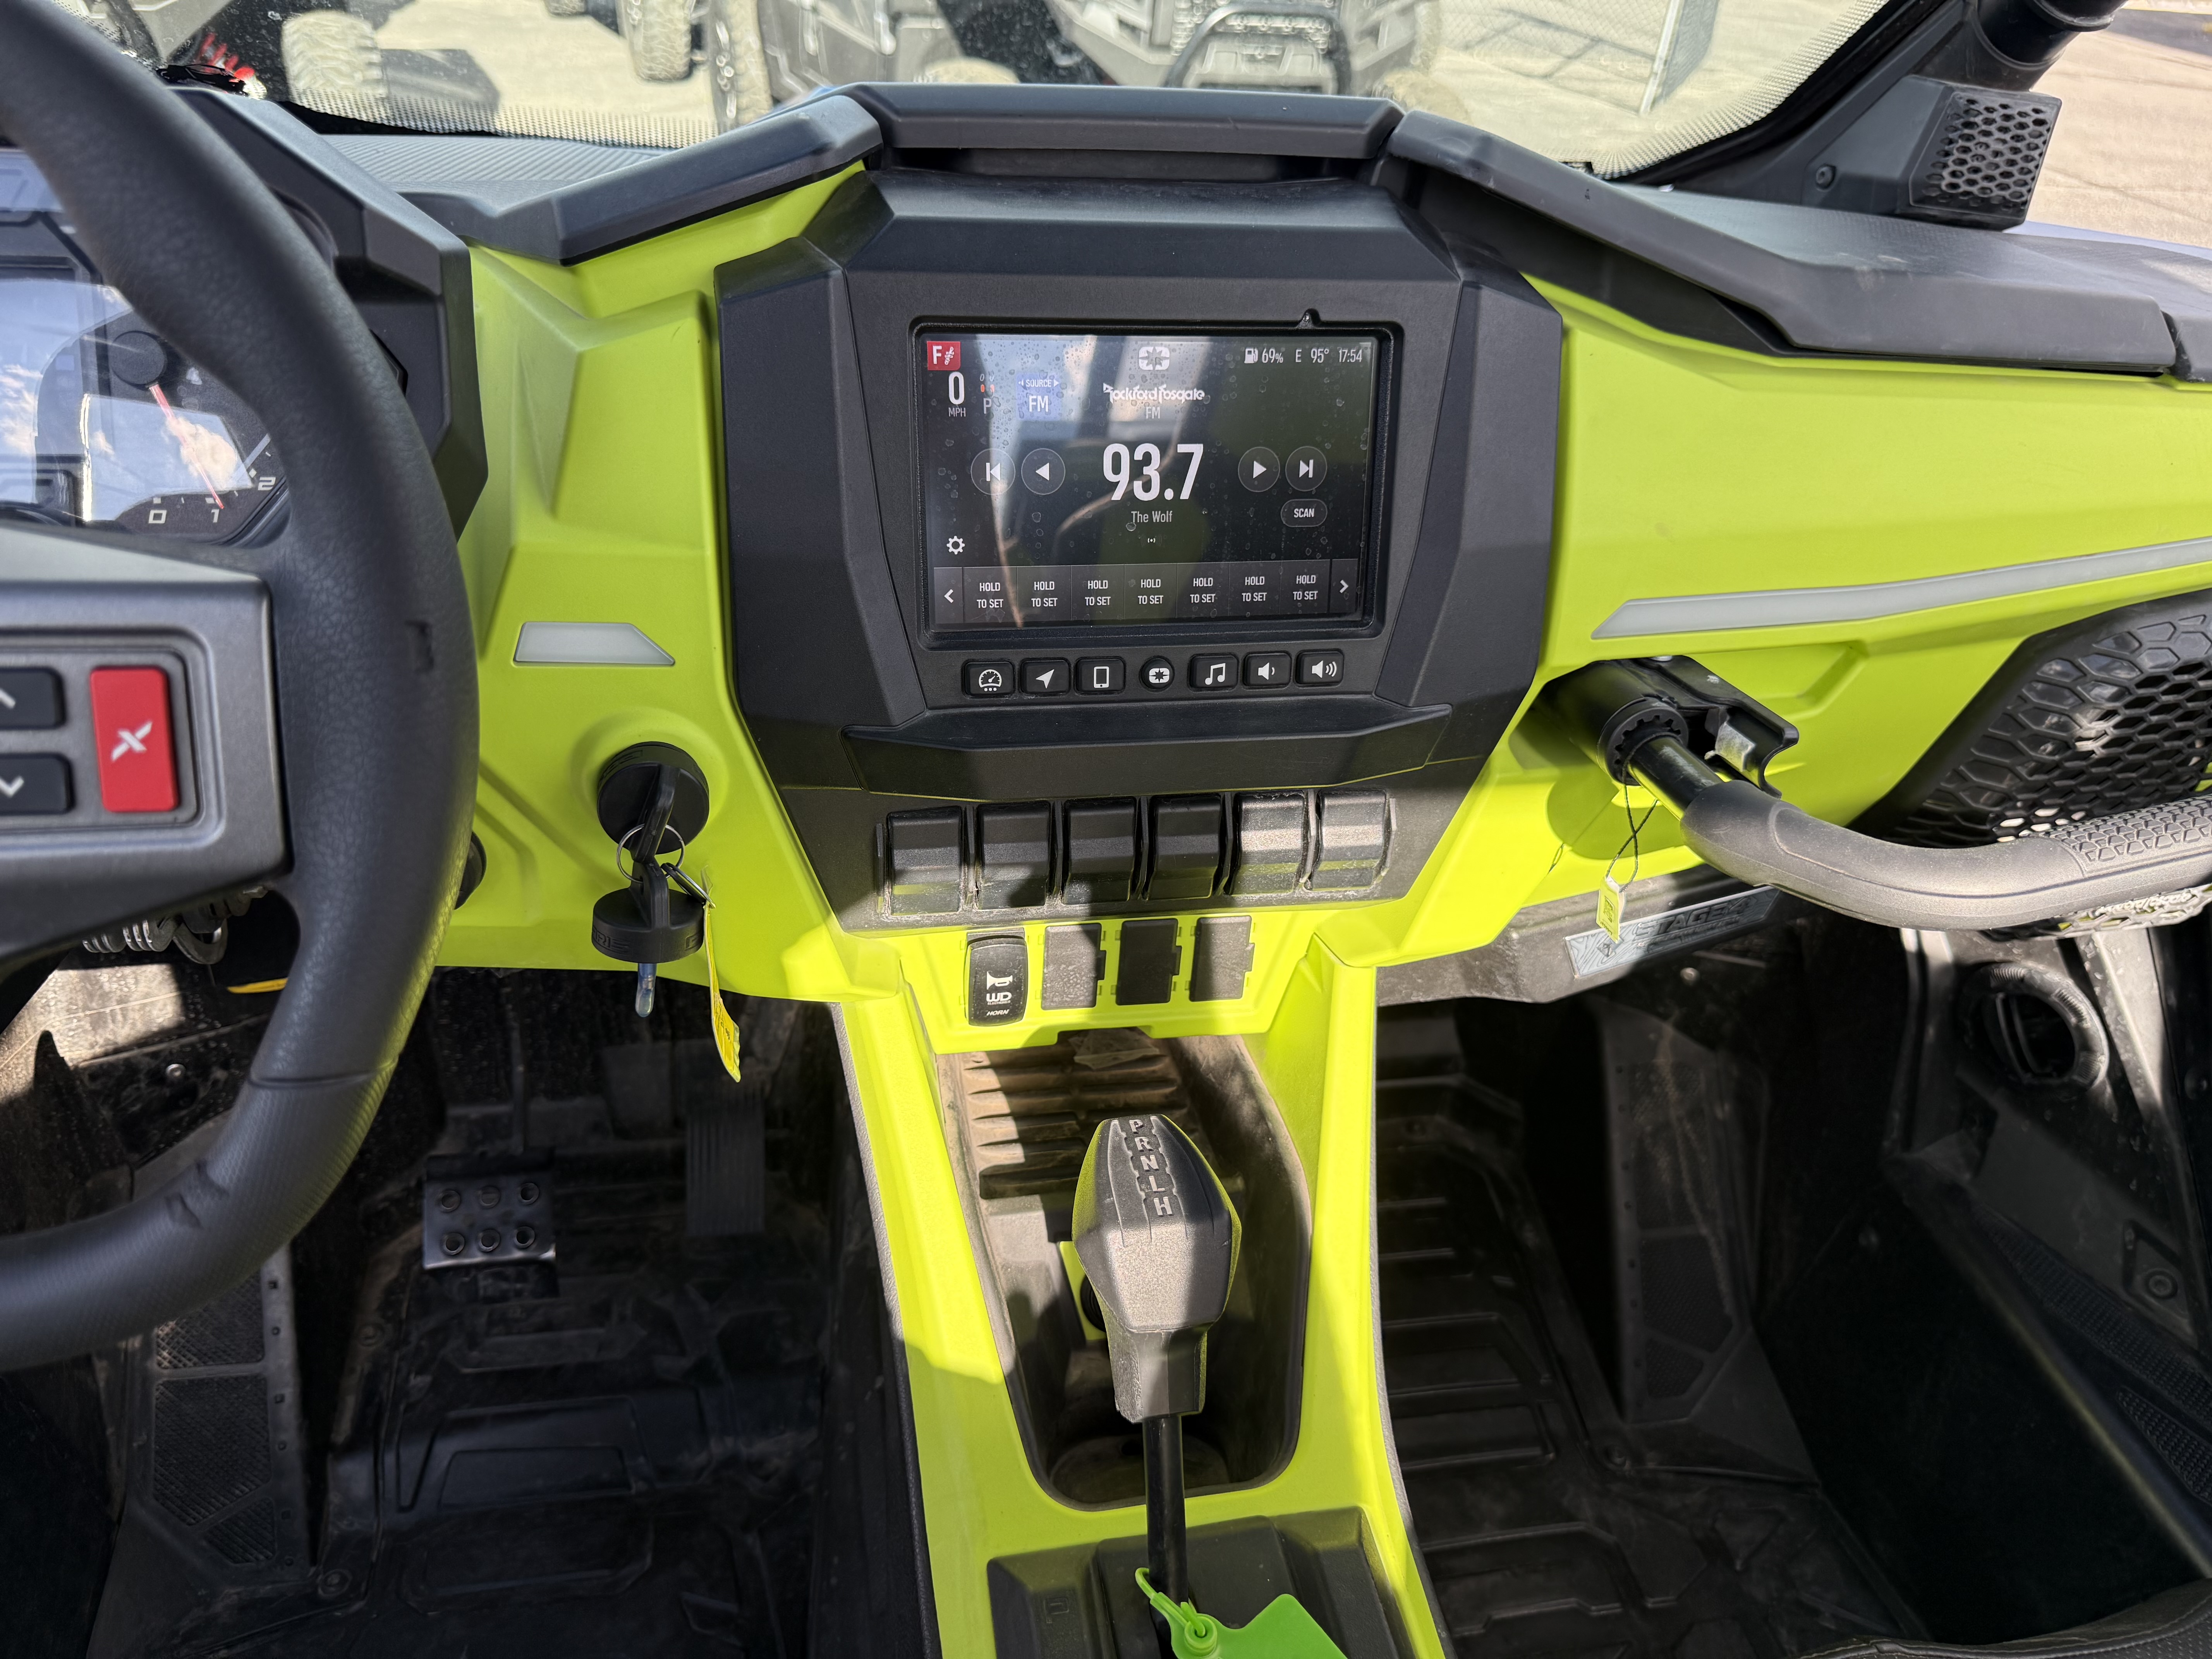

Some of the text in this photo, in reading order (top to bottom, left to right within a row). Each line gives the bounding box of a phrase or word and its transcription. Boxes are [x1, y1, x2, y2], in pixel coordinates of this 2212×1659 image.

[1262, 348, 1283, 363] 69%
[1295, 349, 1302, 362] E
[1339, 349, 1362, 362] 17:54
[948, 371, 965, 405] 0
[1025, 379, 1052, 387] SOURCE
[983, 398, 992, 414] P
[1029, 395, 1049, 412] FM
[948, 407, 966, 417] MPH
[1146, 407, 1160, 419] FM
[1103, 443, 1204, 501] 93.7
[258, 477, 276, 491] 2
[148, 510, 167, 524] 0
[211, 509, 220, 523] 1
[1131, 510, 1173, 523] The Wolf
[1293, 508, 1315, 518] SCAN
[1088, 580, 1108, 589] HOLD
[1141, 579, 1161, 588] HOLD
[1193, 577, 1213, 587] HOLD
[1245, 576, 1265, 586] HOLD
[1296, 575, 1316, 584] HOLD
[979, 582, 1000, 592] HOLD
[1034, 581, 1054, 591] HOLD
[1137, 595, 1164, 604] TO SET
[1190, 594, 1216, 603] TO SET
[1242, 592, 1267, 602] TO SET
[1293, 591, 1318, 600] TO SET
[976, 599, 1004, 608] TO SET
[1031, 598, 1058, 607] TO SET
[1085, 596, 1111, 606] TO SET
[986, 992, 1012, 1002] WD
[1129, 1120, 1143, 1134] P
[1135, 1137, 1154, 1152] R
[1140, 1154, 1159, 1171] N
[1149, 1176, 1165, 1193] L
[1154, 1197, 1173, 1216] H
